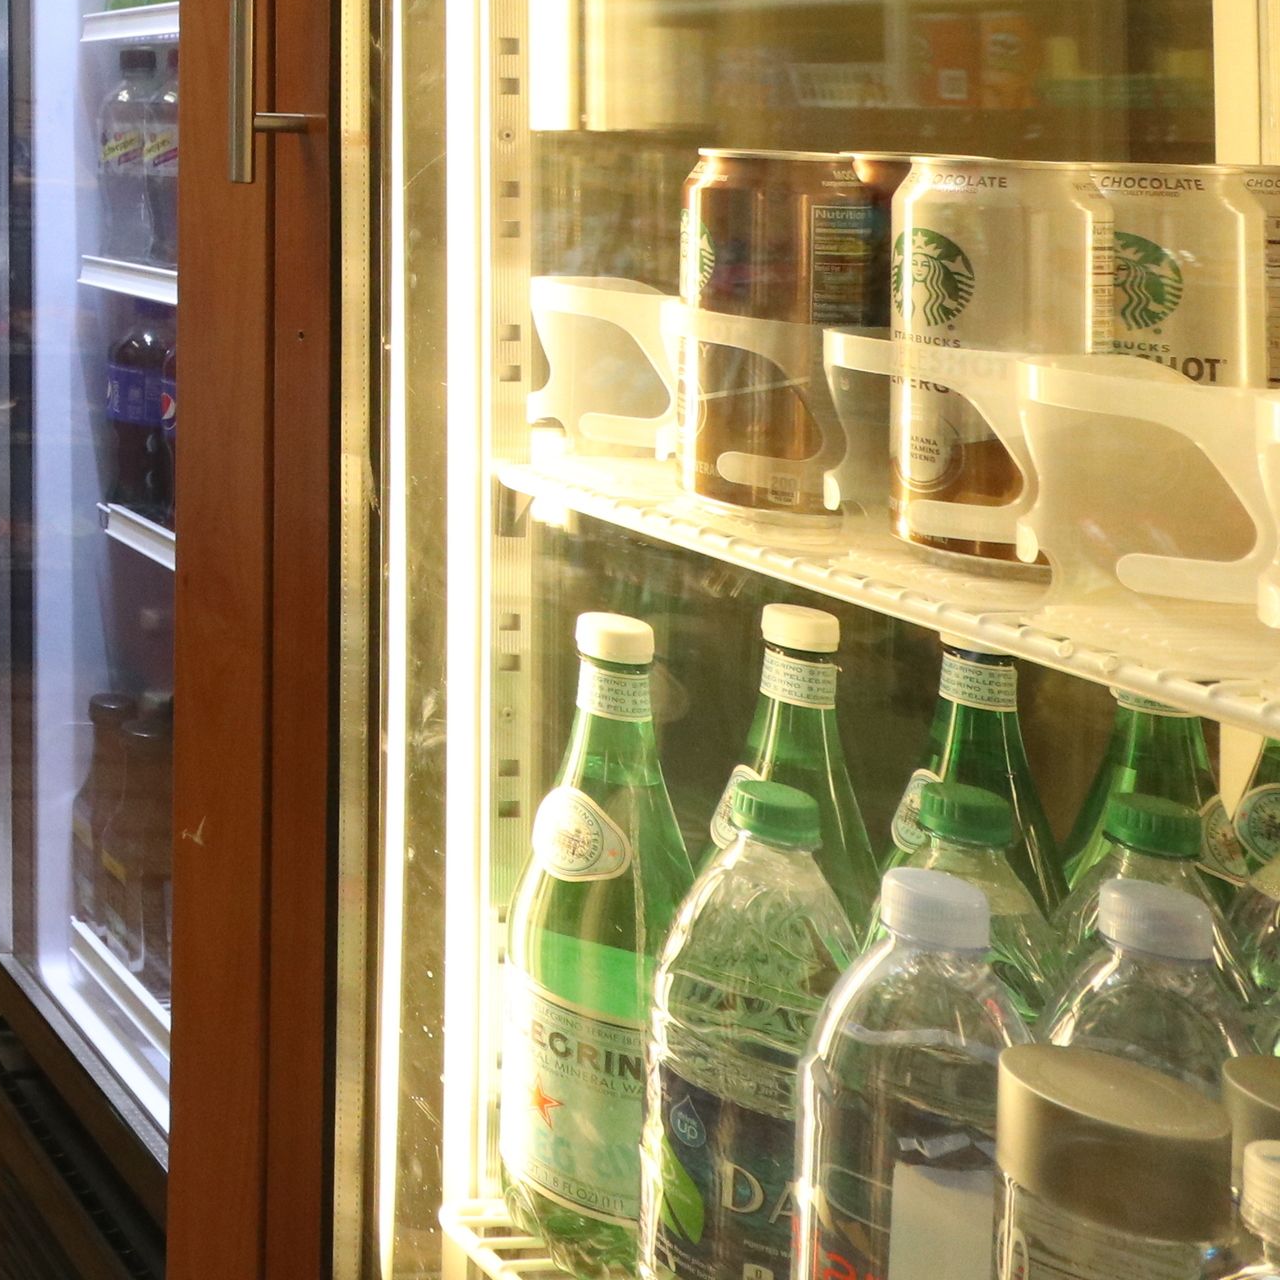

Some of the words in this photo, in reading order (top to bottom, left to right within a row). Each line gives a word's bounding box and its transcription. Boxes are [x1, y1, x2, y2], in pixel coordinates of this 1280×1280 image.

[1100, 175, 1205, 192] CHOCOLATE
[1246, 178, 1280, 189] CHOC
[1112, 340, 1171, 353] BUCKS
[911, 445, 940, 456] TAMINS
[556, 1061, 617, 1091] MINERAL
[562, 1183, 573, 1196] FL
